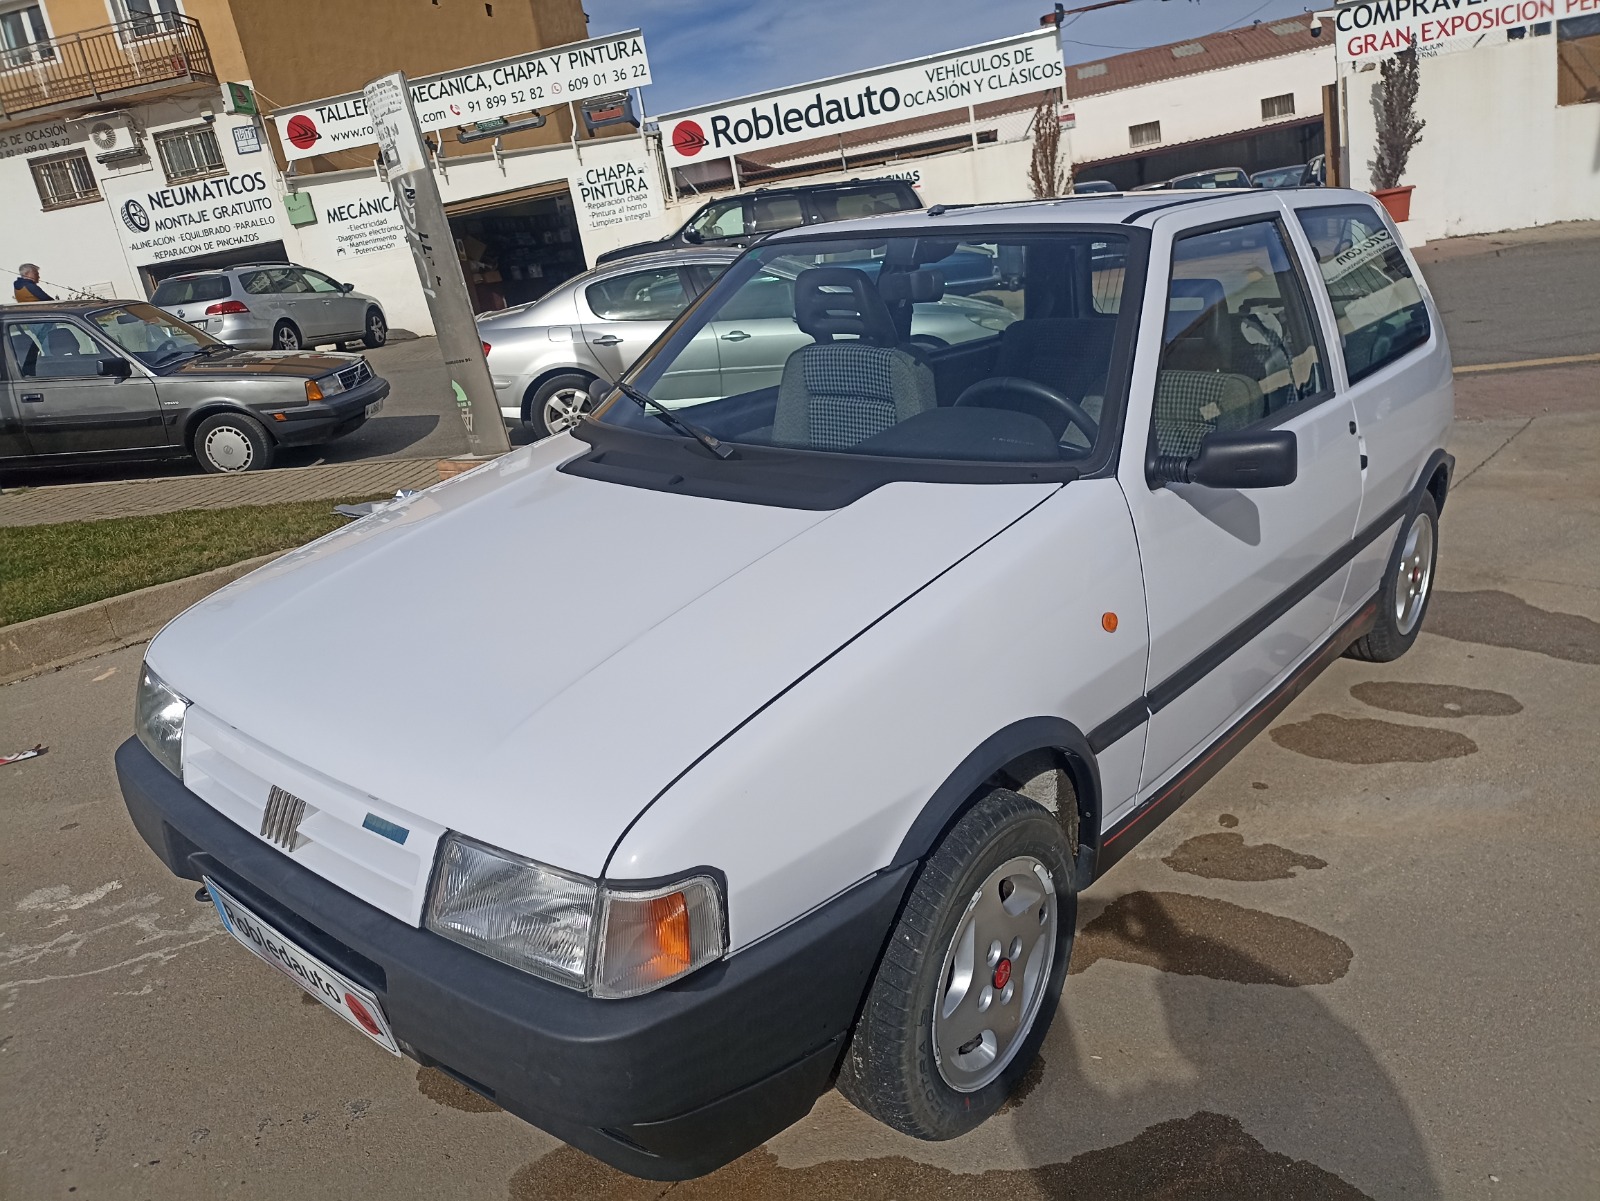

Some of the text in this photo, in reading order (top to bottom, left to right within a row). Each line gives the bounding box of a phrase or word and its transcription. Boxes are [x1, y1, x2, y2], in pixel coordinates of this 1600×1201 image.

[1347, 0, 1600, 56] GRAN EXPOSICION PE
[493, 59, 548, 86] CHAPA
[550, 55, 562, 73] Y
[568, 38, 643, 70] PINTURA
[925, 47, 1034, 83] VEHÍCULOS DE
[467, 100, 481, 113] 91
[486, 94, 507, 110] 899
[511, 90, 524, 104] 52
[529, 86, 545, 99] 82
[568, 77, 589, 92] 609
[593, 73, 607, 86] 01
[613, 68, 627, 82] 36
[633, 63, 647, 78] 22
[903, 62, 1063, 107] OCASIÓN Y CLÁSICOS
[9, 134, 24, 146] DE
[25, 123, 68, 142] OCASIÓN
[710, 85, 900, 149] Robledauto
[24, 144, 37, 154] 609
[50, 139, 60, 149] 36
[581, 176, 648, 202] PINTURA
[586, 162, 637, 184] CHAPA
[147, 172, 266, 211] NEUMÁTICOS
[627, 193, 648, 202] chapa
[154, 197, 272, 232] MONTAJE GRATUITO
[589, 209, 616, 219] -Pintura
[626, 202, 648, 212] horno
[589, 210, 651, 228] -Limpieza integral
[203, 241, 214, 251] DE
[216, 232, 260, 248] PINCHAZOS
[222, 902, 341, 1004] Robledauto
